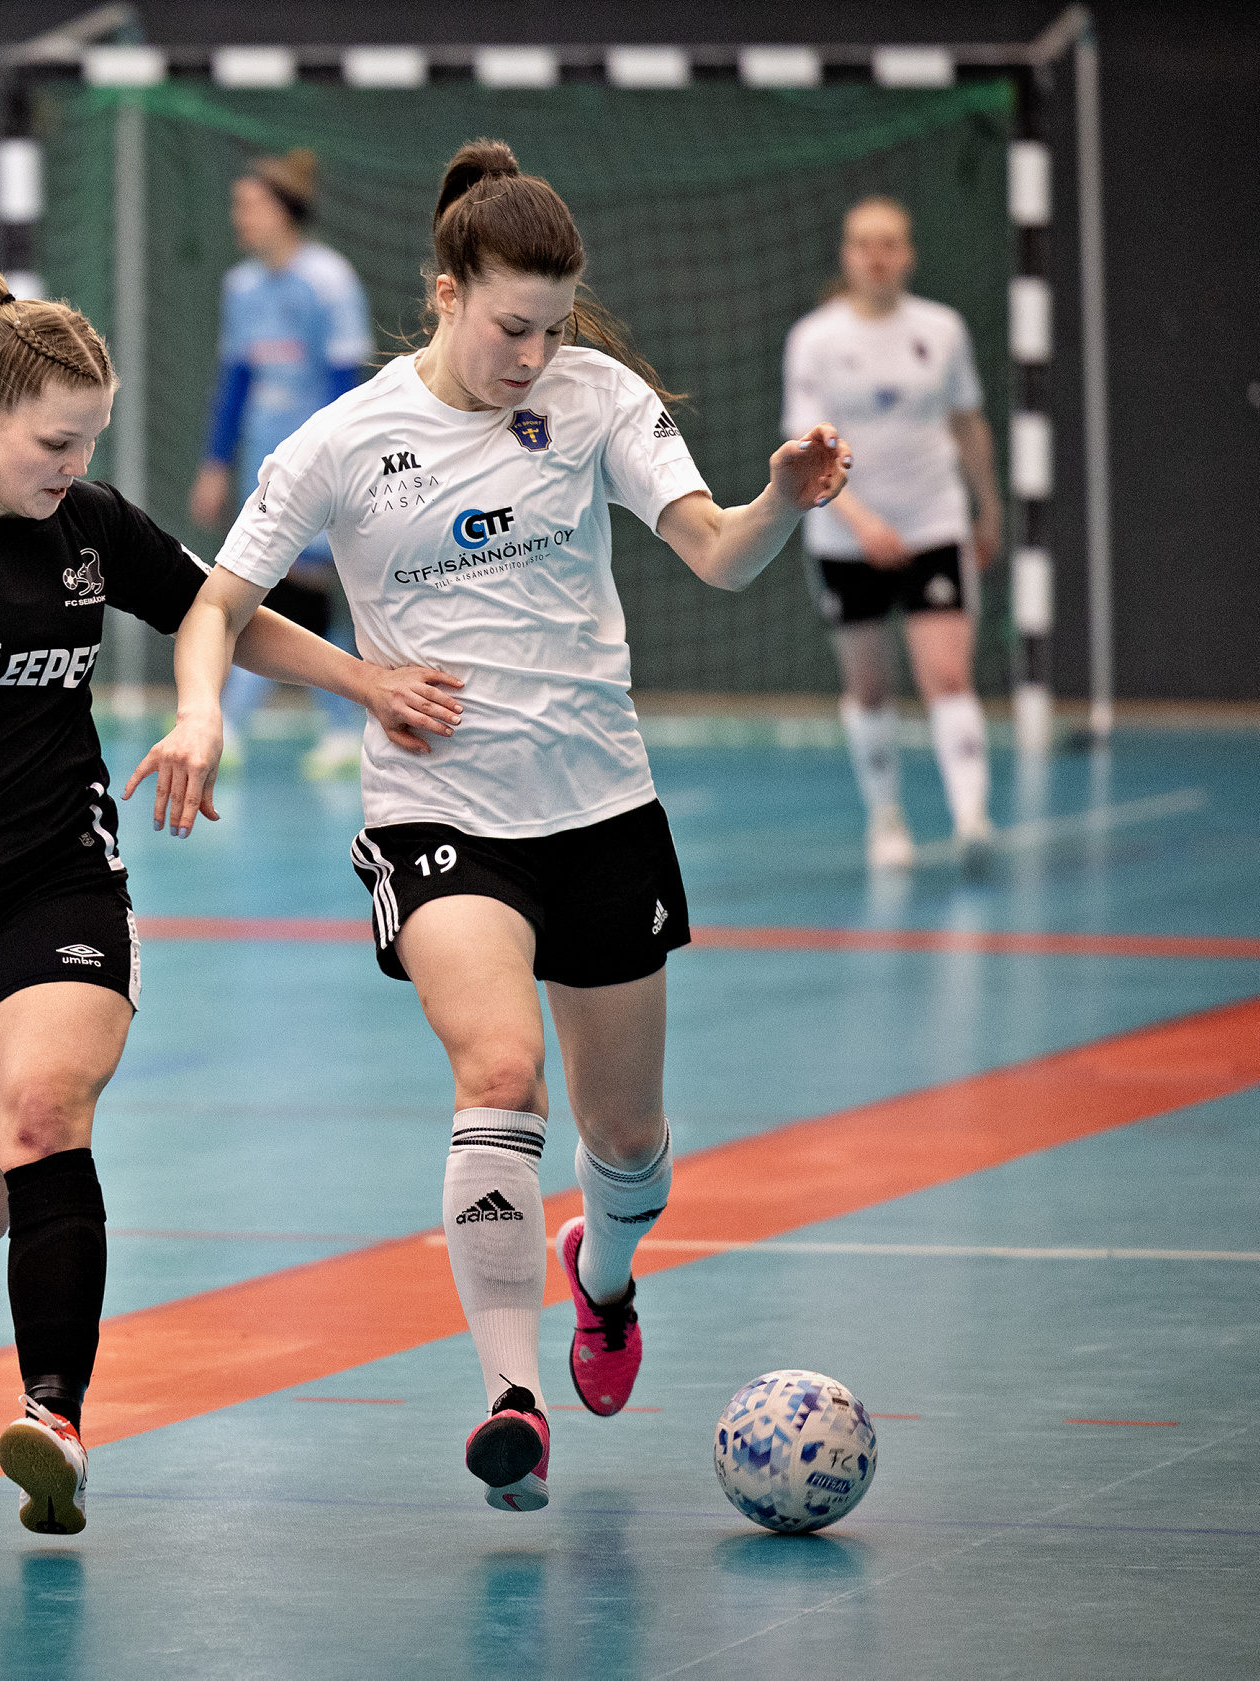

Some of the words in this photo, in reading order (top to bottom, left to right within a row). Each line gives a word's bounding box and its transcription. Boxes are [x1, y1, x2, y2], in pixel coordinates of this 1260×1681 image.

[653, 428, 681, 439] adida
[381, 451, 422, 476] XXL
[368, 475, 439, 498] VAASA
[464, 506, 515, 540] CTF
[394, 536, 549, 584] CTF-ISÄNNÖINTI
[554, 529, 575, 546] OY
[64, 599, 78, 607] FC
[414, 844, 457, 877] 19
[61, 956, 102, 968] umbro
[455, 1209, 525, 1225] adidas
